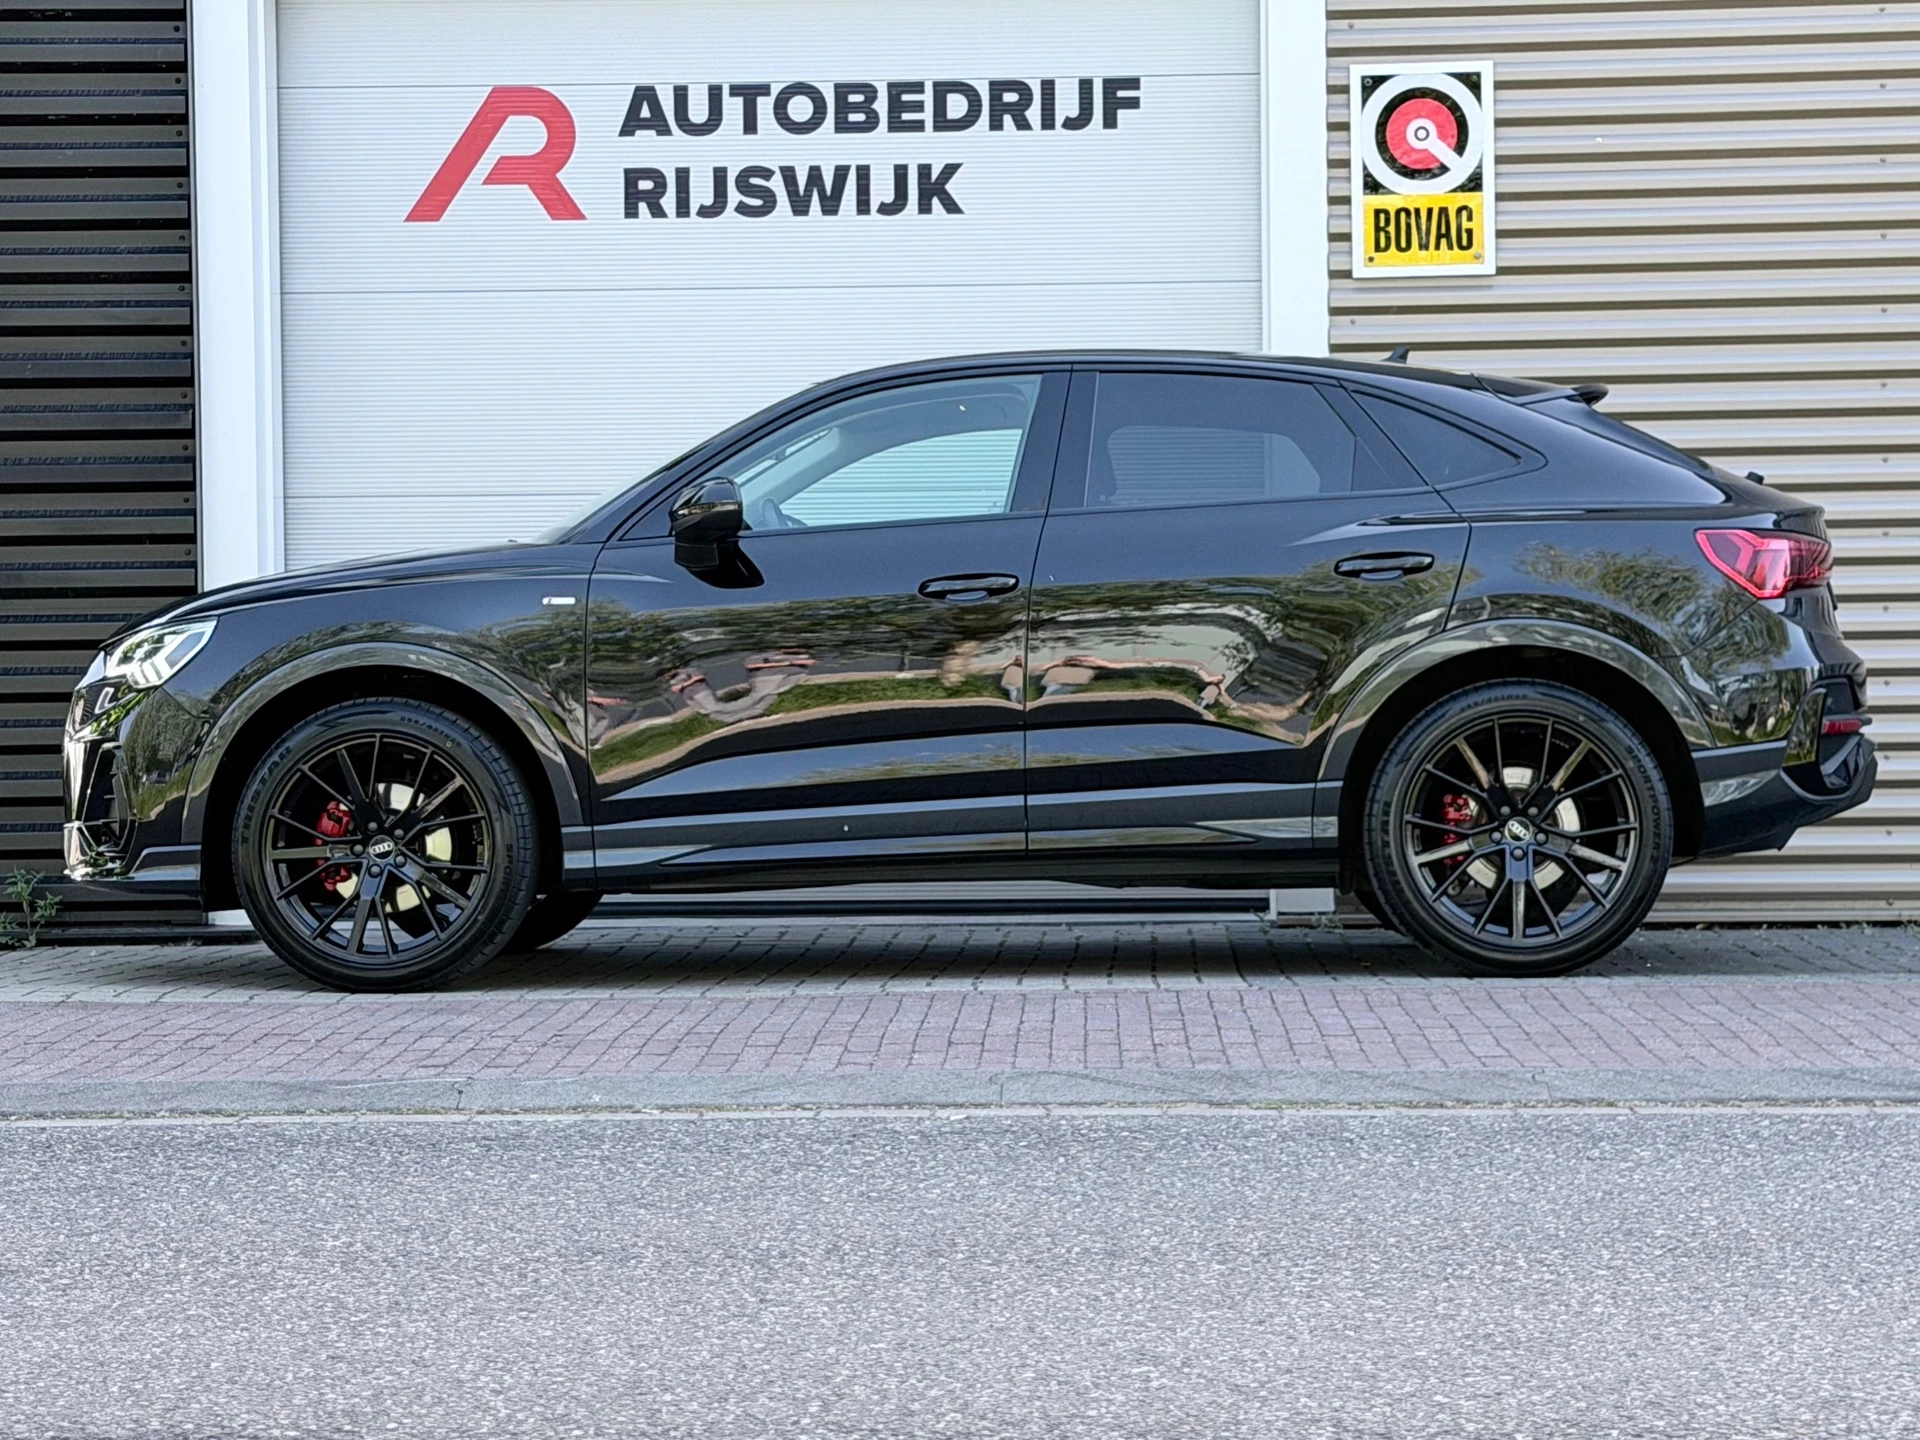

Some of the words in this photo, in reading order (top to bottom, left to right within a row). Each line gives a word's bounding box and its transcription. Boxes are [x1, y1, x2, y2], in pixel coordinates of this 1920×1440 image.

[619, 77, 1141, 137] AUTOBEDRIJF
[623, 163, 965, 219] RIJSWIJK
[1373, 205, 1474, 253] BOVAG
